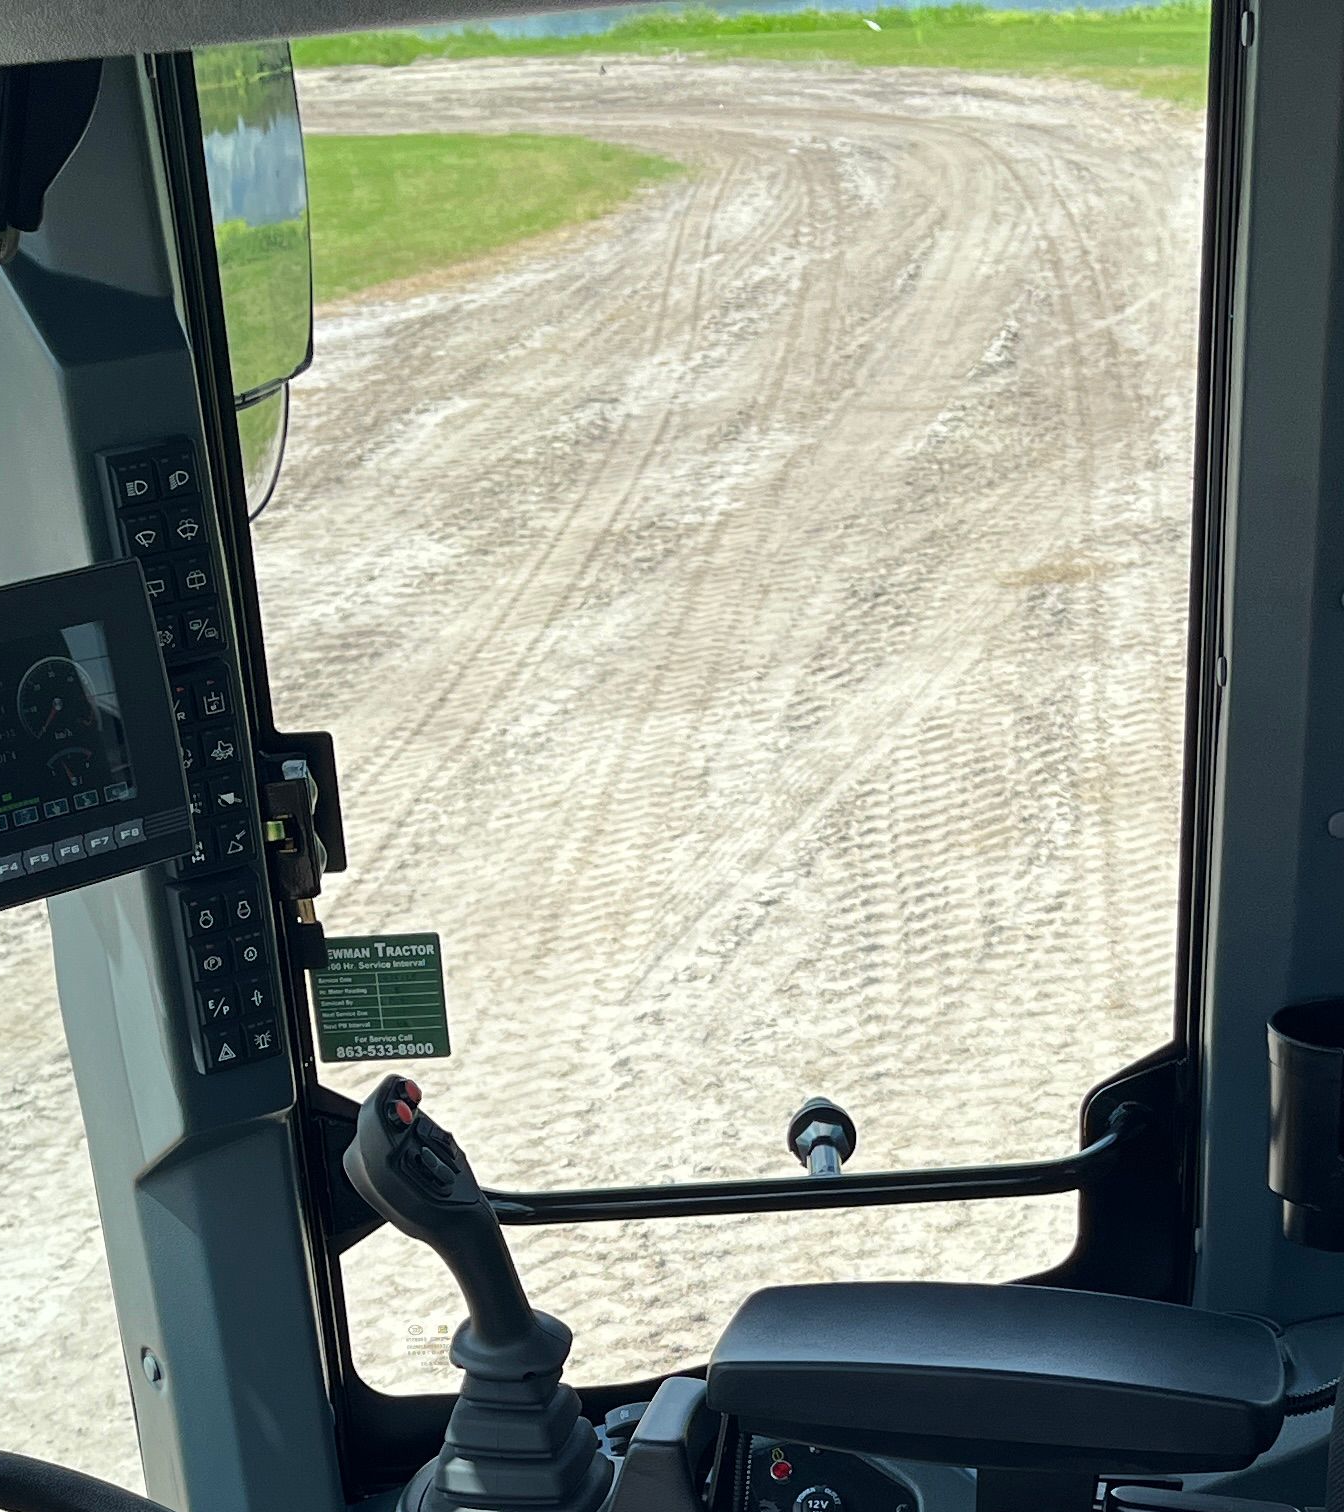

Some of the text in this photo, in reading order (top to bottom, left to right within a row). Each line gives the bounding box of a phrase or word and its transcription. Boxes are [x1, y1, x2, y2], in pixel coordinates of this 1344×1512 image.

[29, 853, 50, 866] F5
[60, 844, 80, 857] F6
[90, 836, 109, 848] F7
[120, 827, 140, 840] F8
[328, 947, 371, 960] EWMAN
[327, 963, 342, 971] 00
[359, 961, 391, 970] Service
[392, 958, 426, 968] Interval
[354, 1033, 413, 1044] For Service Call
[336, 1042, 434, 1059] 863-533-8900
[807, 1500, 829, 1509] 12V
